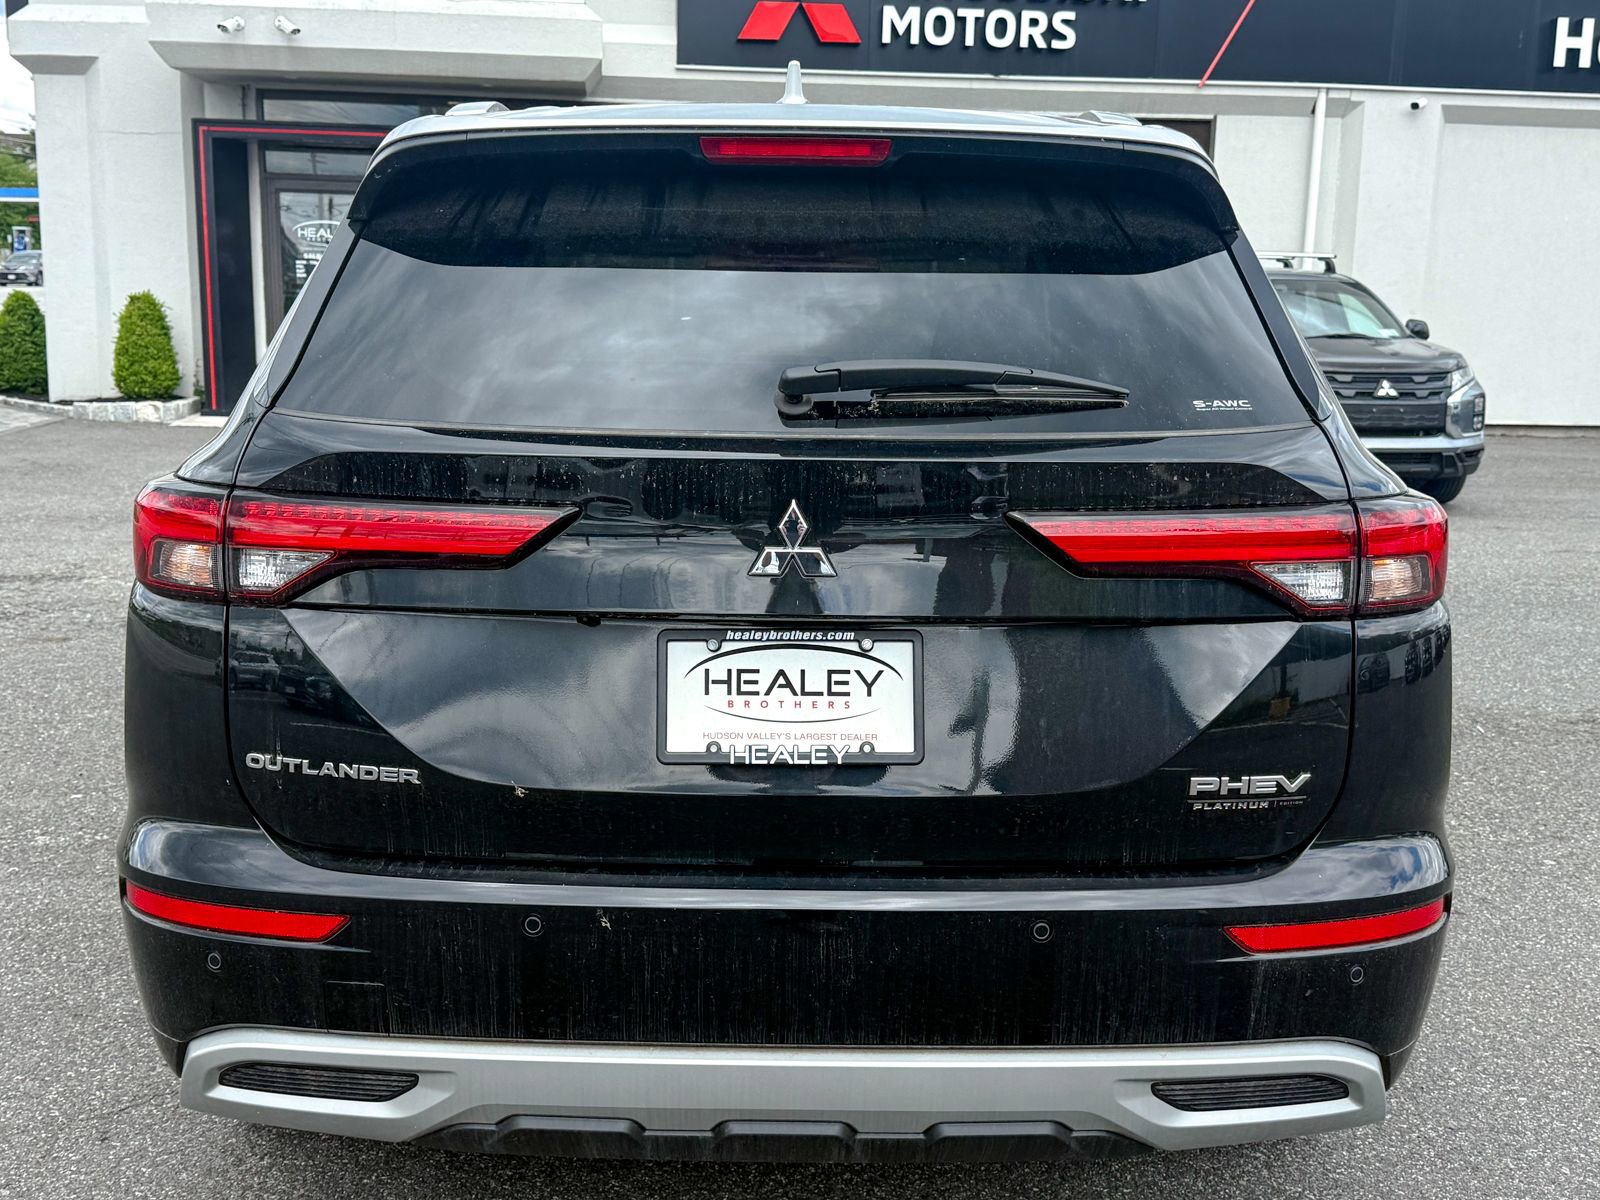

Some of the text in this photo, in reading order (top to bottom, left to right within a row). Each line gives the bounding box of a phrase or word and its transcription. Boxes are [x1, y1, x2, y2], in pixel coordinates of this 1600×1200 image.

[881, 5, 1077, 50] MOTORS
[1553, 16, 1600, 69] H
[297, 228, 333, 238] HEAL
[1192, 399, 1251, 407] S-AWC
[726, 630, 855, 642] healeybrothers.com
[704, 668, 885, 697] HEALEY
[727, 700, 851, 710] BROTHERS
[702, 732, 878, 742] HUDSON VALLEY'S LARGEST DEALER
[729, 744, 851, 765] HEALEY
[245, 753, 422, 785] OUTLANDER
[1189, 773, 1312, 796] PHEV
[1193, 801, 1270, 811] PLATINUM
